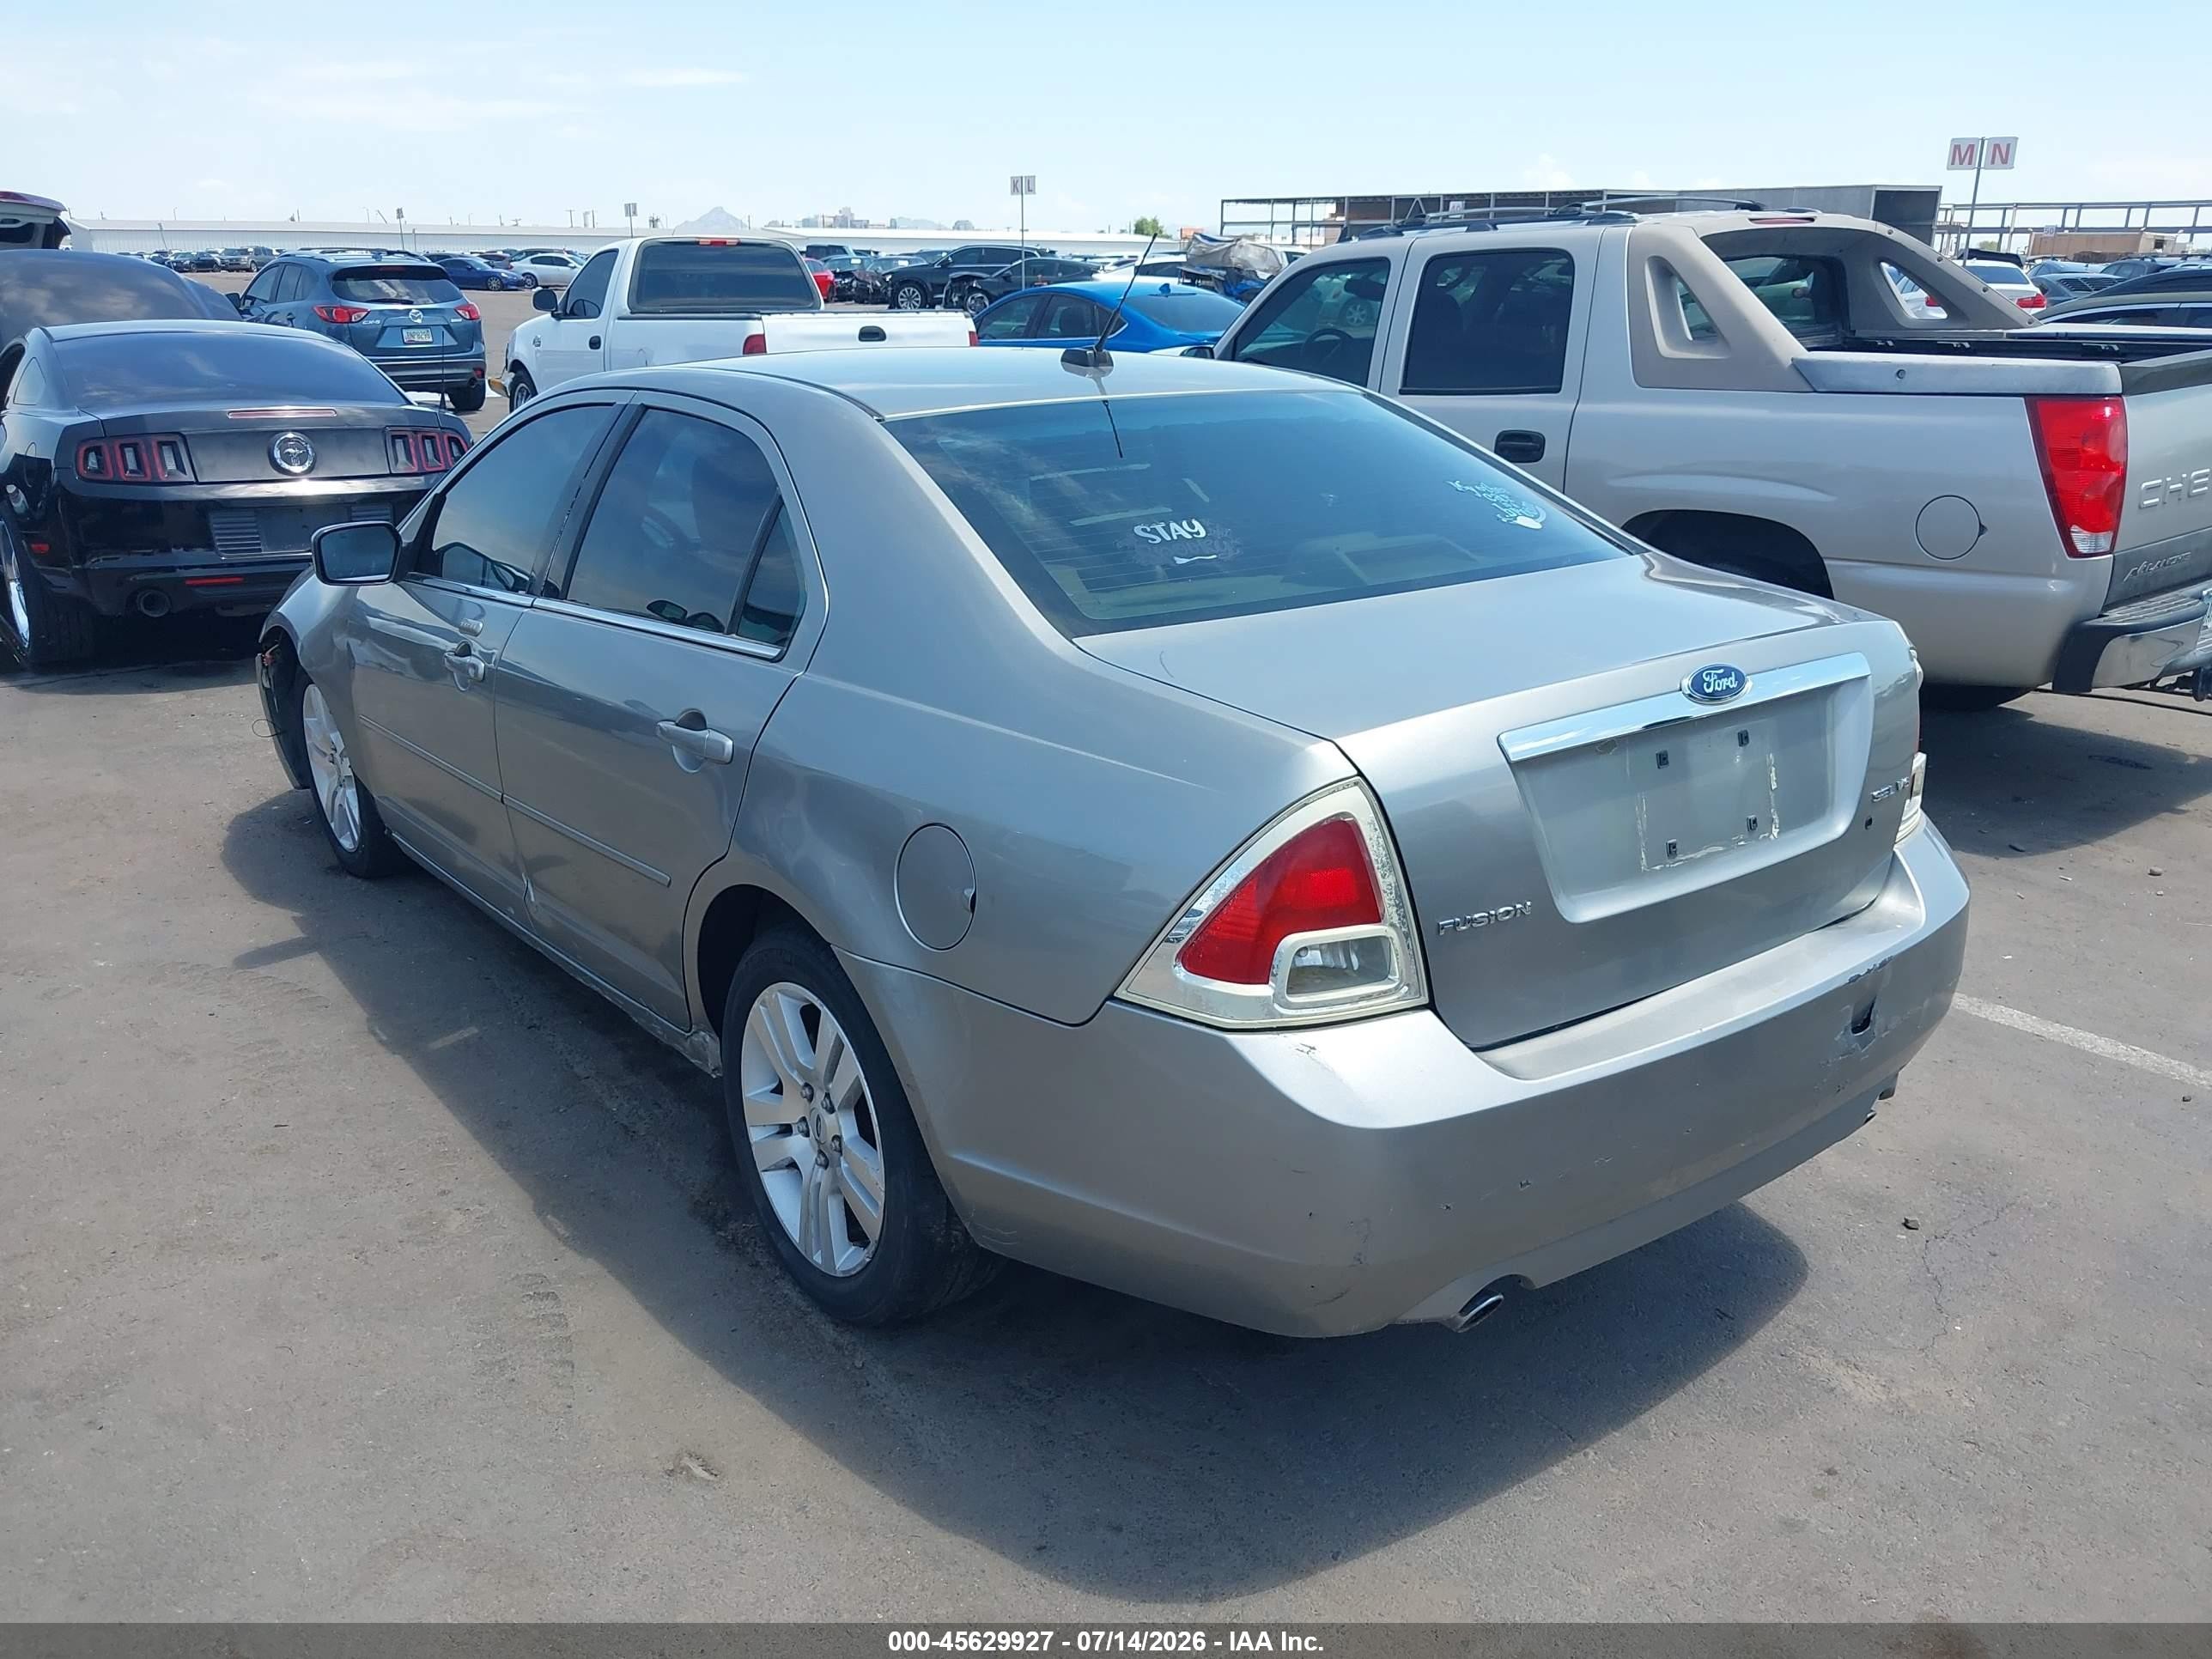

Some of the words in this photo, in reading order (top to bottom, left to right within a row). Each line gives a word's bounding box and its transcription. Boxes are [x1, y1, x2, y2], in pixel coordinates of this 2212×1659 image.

[1951, 143, 1975, 166] M
[1990, 143, 2012, 165] N
[1013, 178, 1020, 192] K
[1027, 178, 1033, 192] L
[1133, 519, 1206, 544] STAY
[1703, 669, 1738, 693] Ford
[1437, 901, 1532, 936] FUSION
